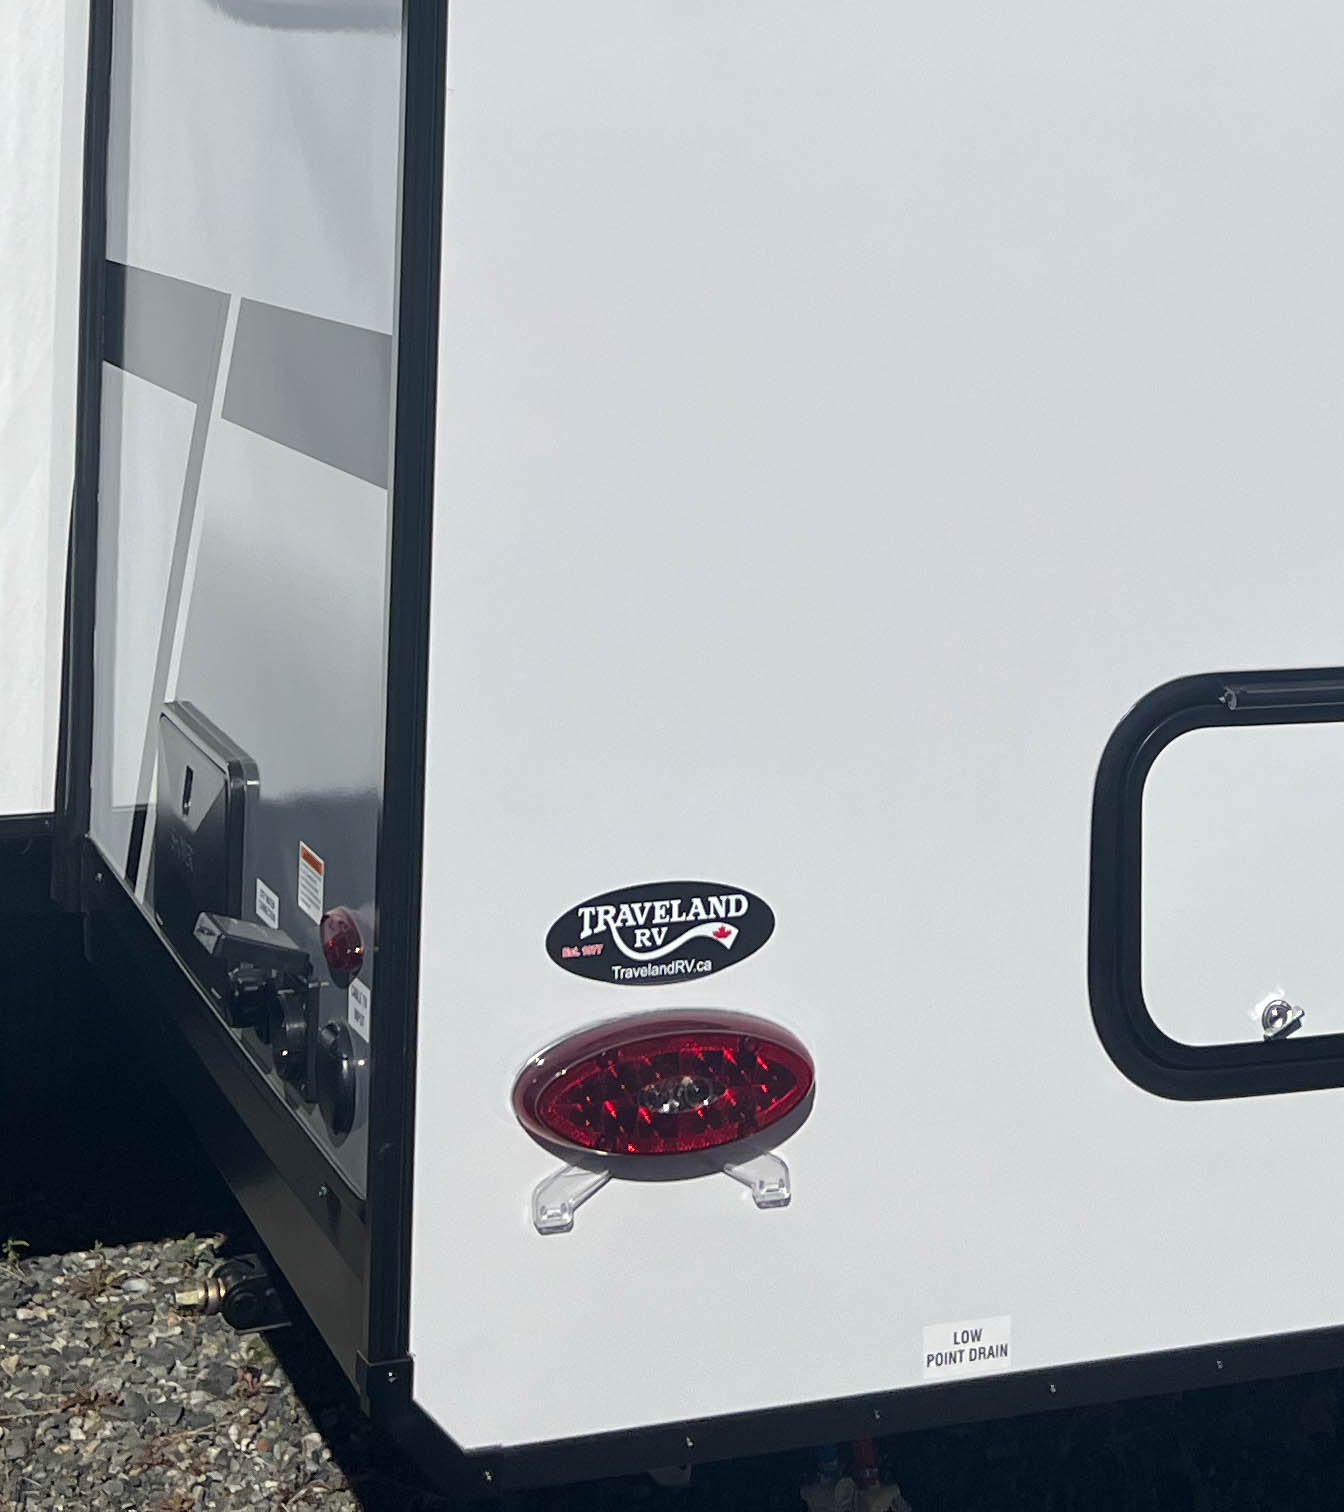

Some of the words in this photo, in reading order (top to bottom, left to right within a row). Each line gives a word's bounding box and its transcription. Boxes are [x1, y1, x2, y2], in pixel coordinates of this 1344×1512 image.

[578, 893, 749, 939] TRAVELAND
[634, 926, 668, 949] RV
[612, 958, 713, 981] TravelandRV.ca
[953, 1328, 983, 1345] LOW
[926, 1349, 965, 1368] POINT
[968, 1343, 1008, 1362] DRAIN
